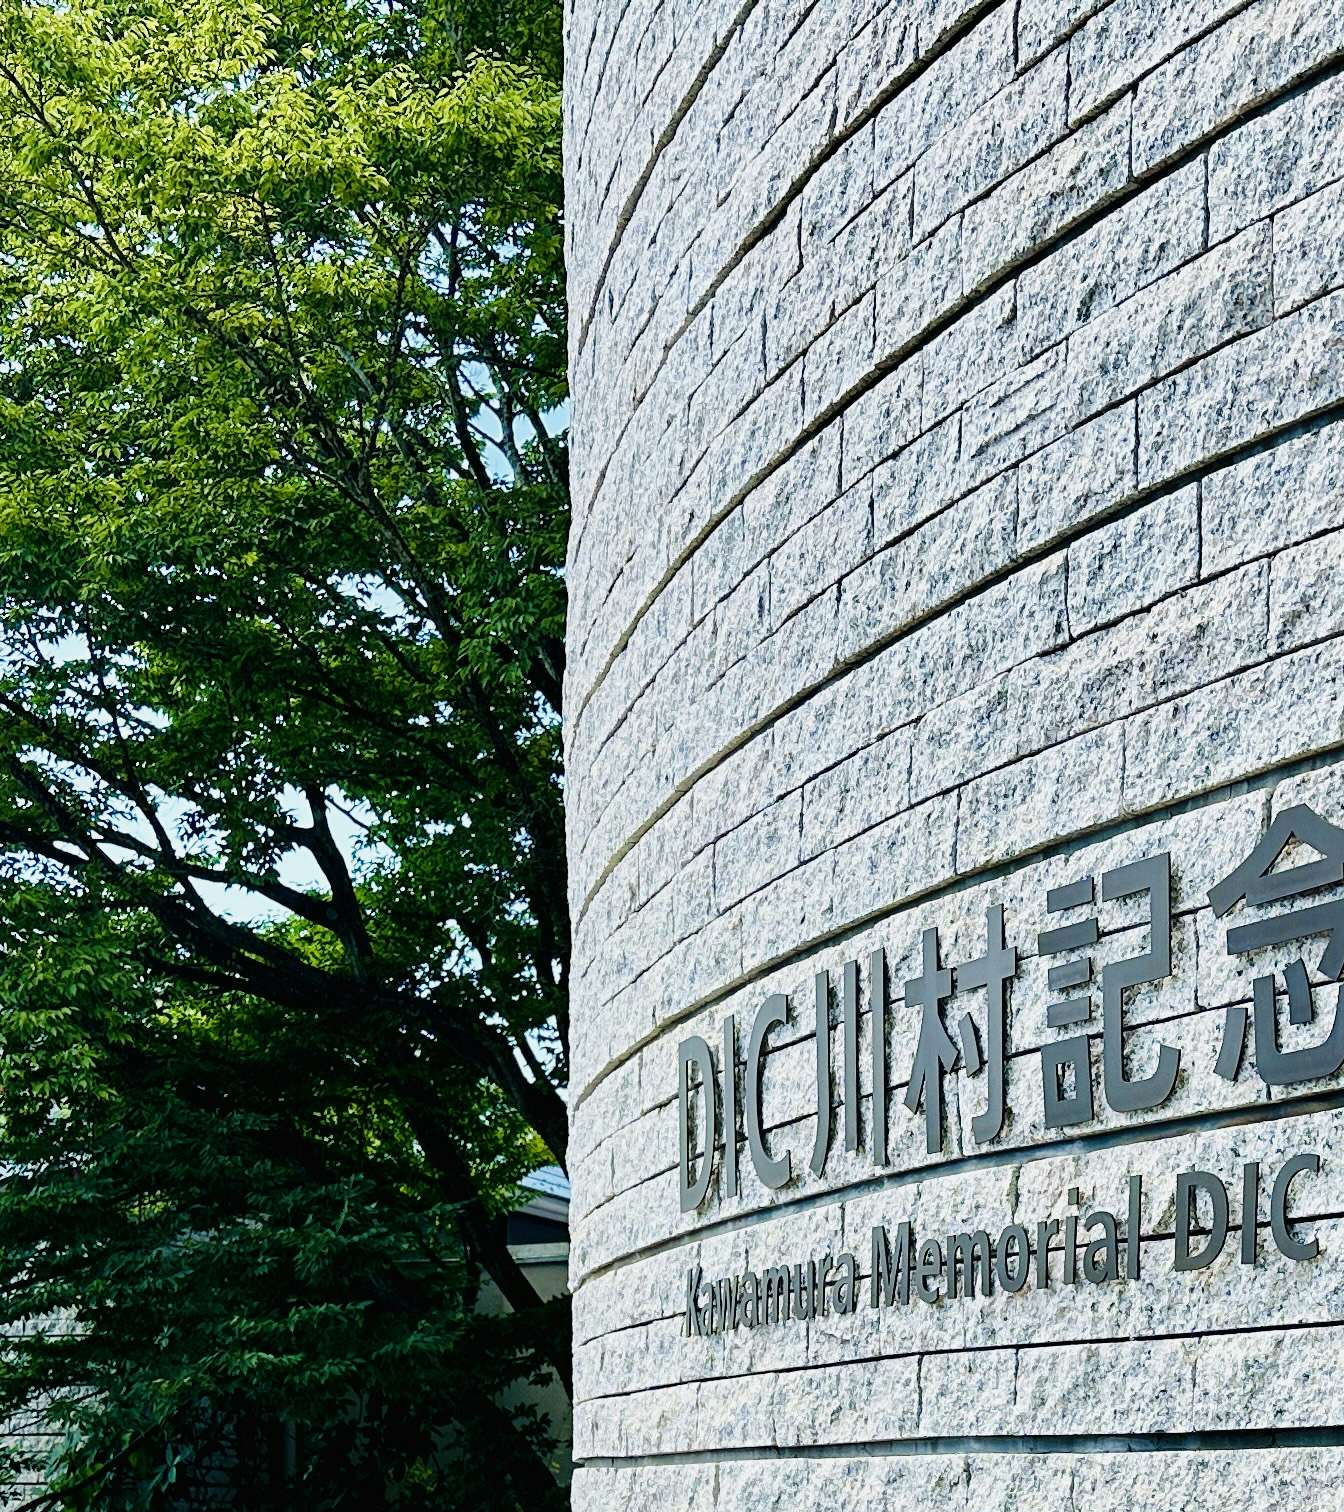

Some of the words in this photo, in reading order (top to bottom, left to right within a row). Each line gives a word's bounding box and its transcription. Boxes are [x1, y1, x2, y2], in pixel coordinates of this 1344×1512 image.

[684, 1246, 857, 1338] Kawamura
[870, 1175, 1142, 1310] Memorial
[1174, 1153, 1321, 1272] DIC
